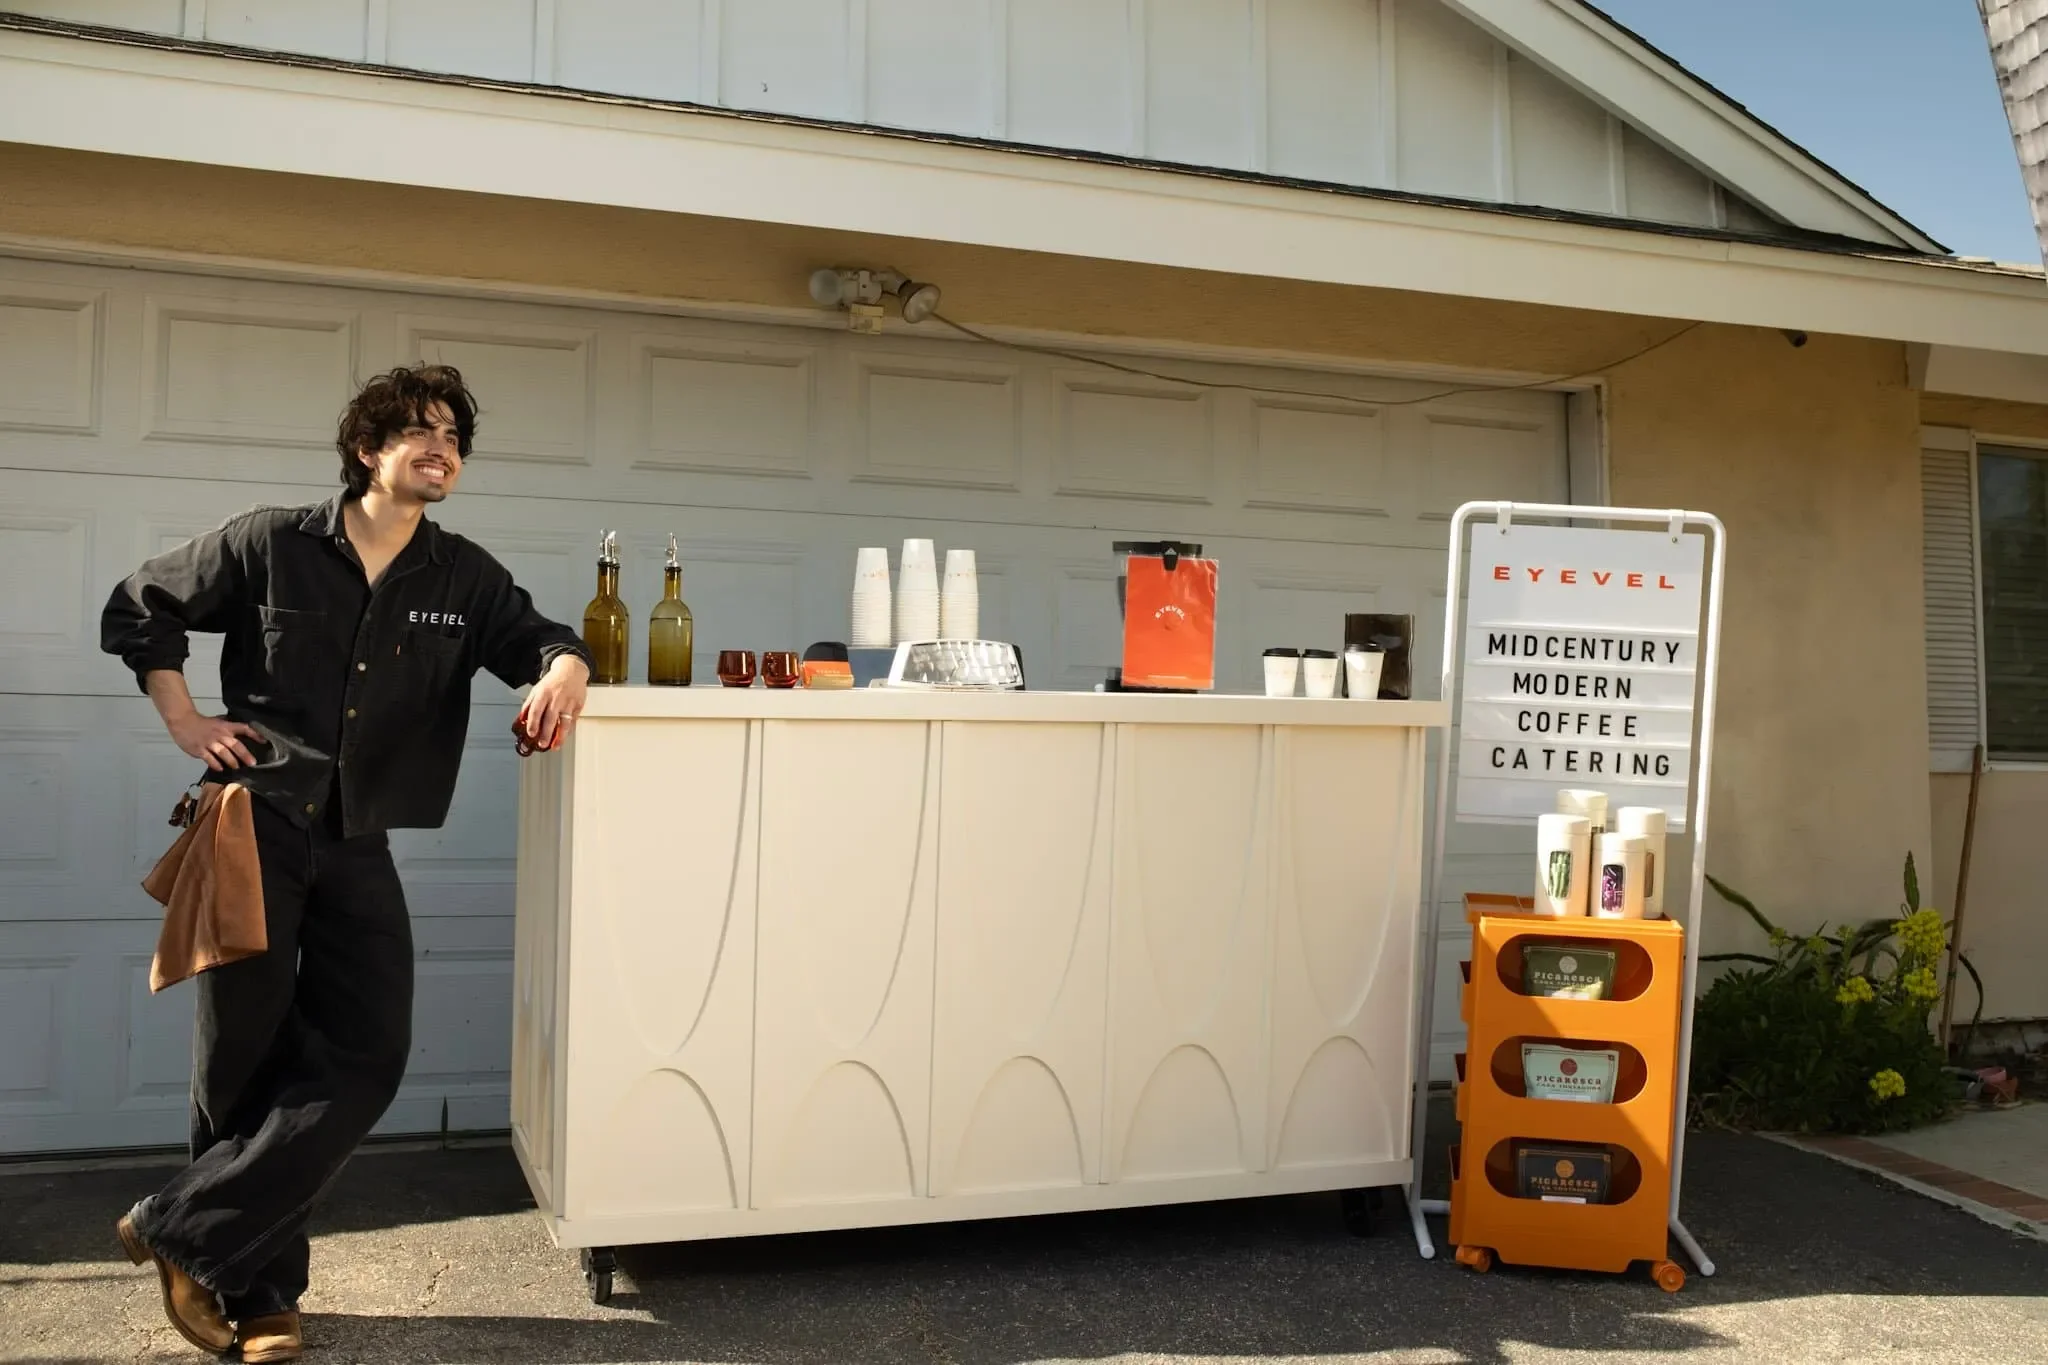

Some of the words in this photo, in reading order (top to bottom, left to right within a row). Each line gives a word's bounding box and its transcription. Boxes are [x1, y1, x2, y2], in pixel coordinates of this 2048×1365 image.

[1494, 566, 1675, 589] EYEVEL
[1488, 633, 1681, 664] MIDCENTURY
[1513, 672, 1632, 699] MODERN
[1518, 711, 1637, 737] COFFEE
[1492, 747, 1670, 777] CATERING
